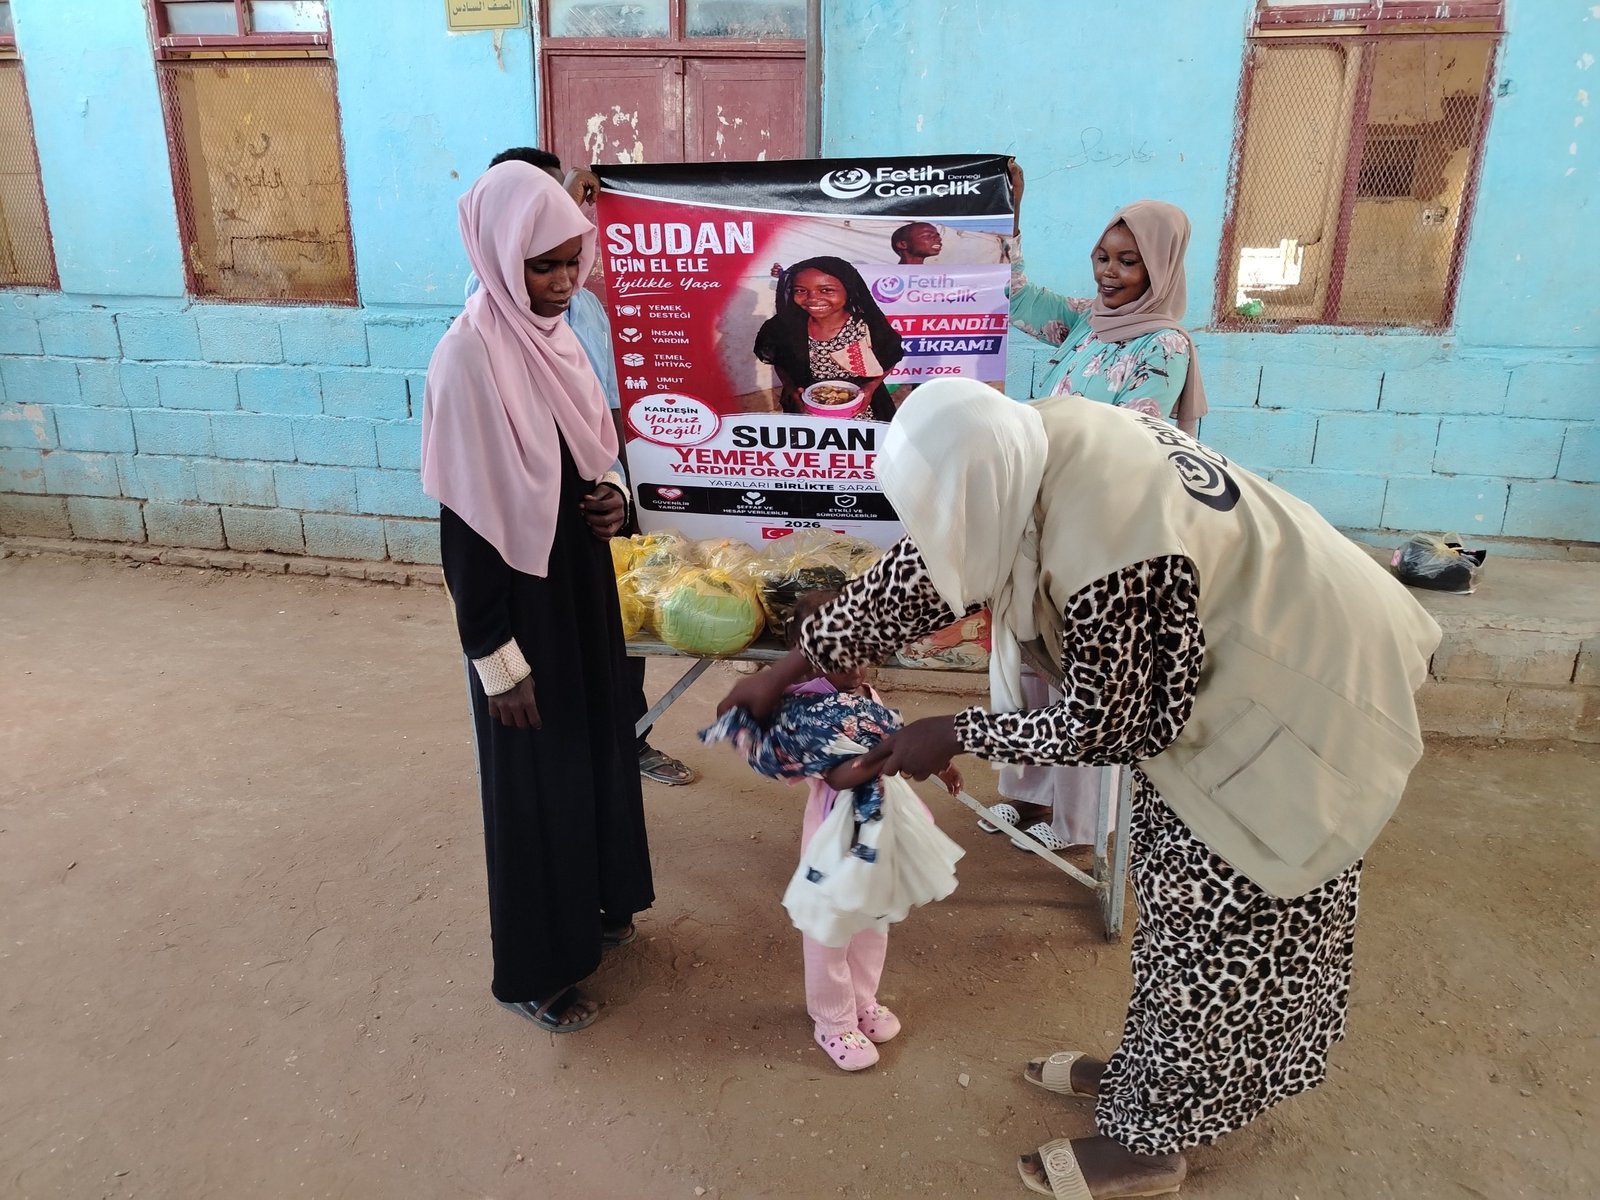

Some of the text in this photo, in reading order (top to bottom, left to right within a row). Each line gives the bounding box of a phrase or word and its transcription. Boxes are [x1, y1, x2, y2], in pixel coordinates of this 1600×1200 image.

[452, 2, 484, 15] السادس
[876, 165, 945, 182] Fetih
[874, 180, 981, 198] Gençlik
[605, 221, 754, 255] SUDAN
[610, 256, 709, 274] İÇİN EL ELE
[612, 275, 722, 294] İyilikle Yaşa
[908, 273, 954, 289] Fetih
[906, 289, 977, 304] Gençlik
[649, 311, 691, 319] DESTEĞİ
[921, 315, 1008, 331] KANDİLİ
[917, 338, 995, 352] İKRAMI
[655, 360, 692, 369] İHTİYAÇ
[890, 366, 961, 376] DAN 2026
[644, 406, 698, 414] KARDEŞİN
[645, 414, 699, 423] Yalnız
[651, 425, 702, 439] Değil!
[732, 425, 875, 451] SUDAN
[674, 448, 776, 468] YEMEK
[783, 452, 820, 468] VE
[669, 463, 876, 480] YARDIM ORGANİZAS
[708, 479, 881, 492] YARALARI BİRLİKTE SARAL
[784, 520, 821, 528] 2026
